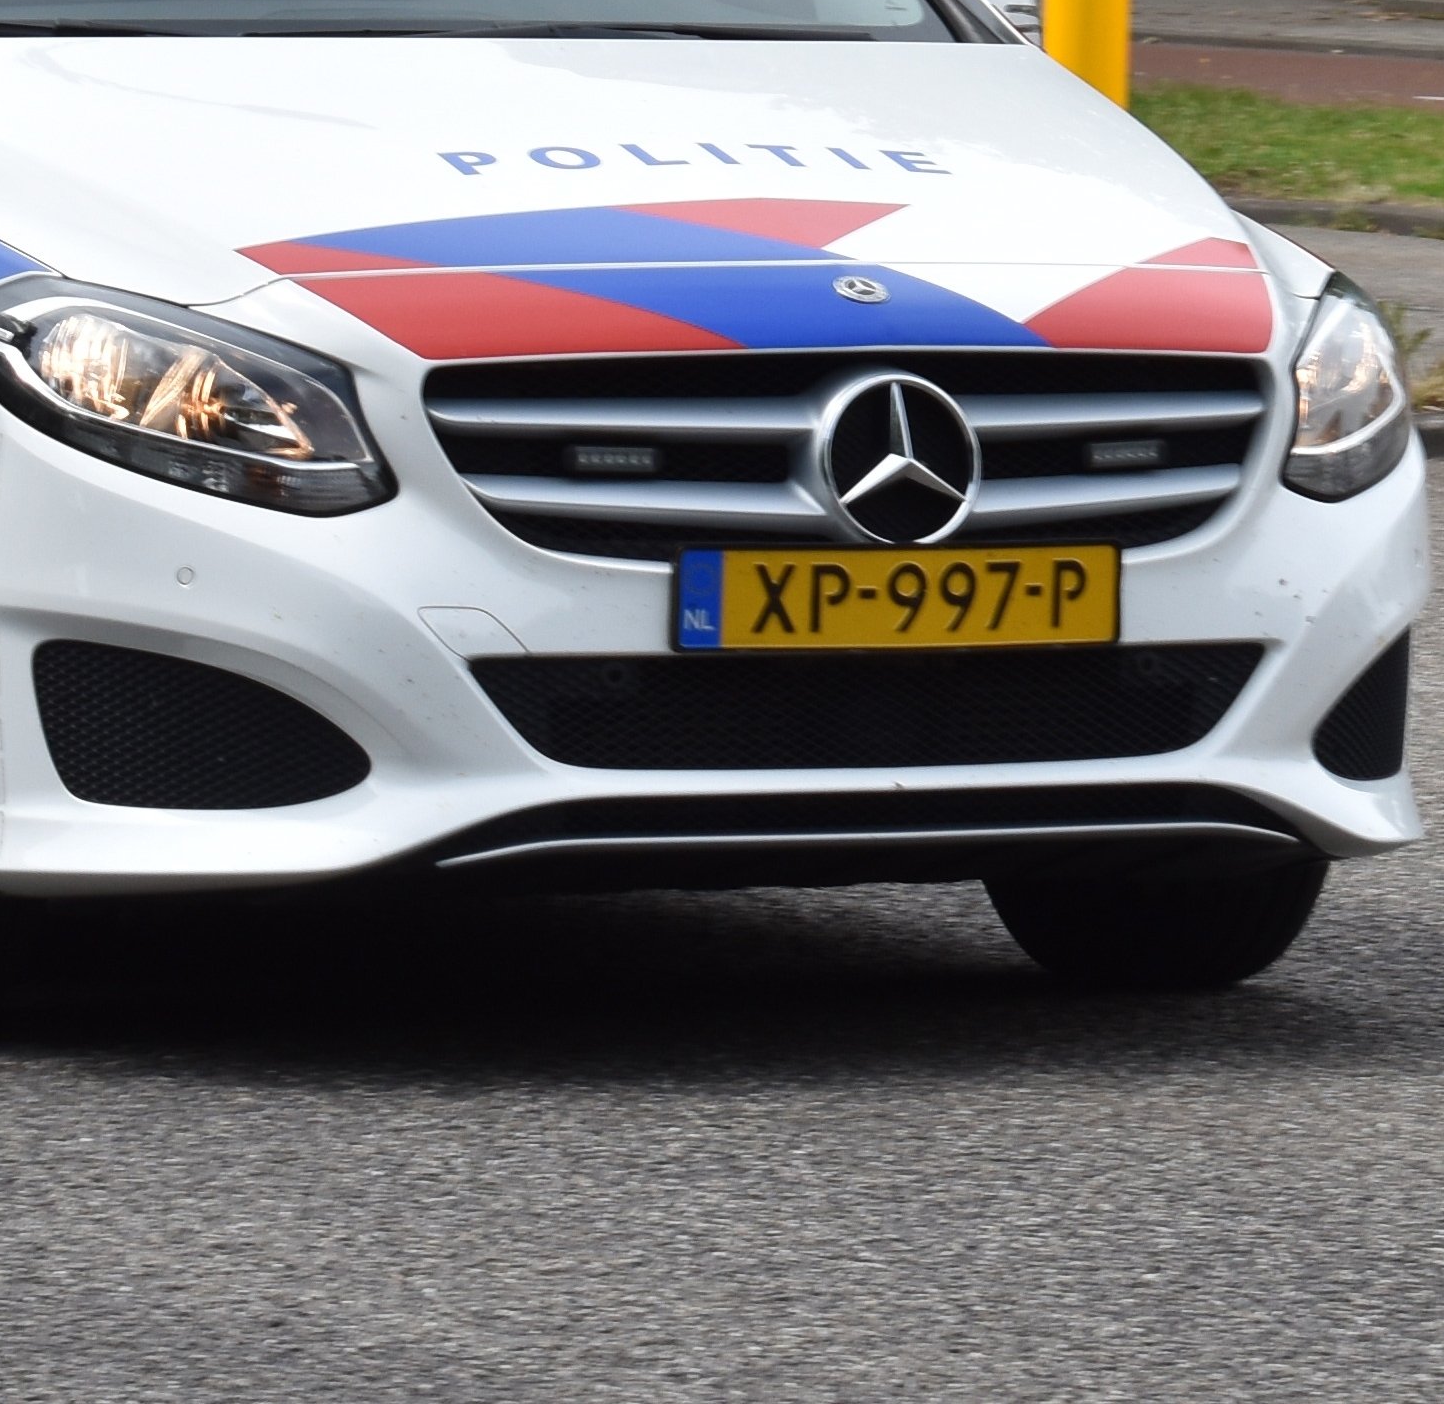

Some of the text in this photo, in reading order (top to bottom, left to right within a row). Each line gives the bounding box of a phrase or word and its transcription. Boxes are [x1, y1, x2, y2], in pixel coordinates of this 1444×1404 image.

[437, 142, 953, 176] POLITIE
[750, 557, 1088, 634] XP-997-P
[682, 609, 717, 632] NL
